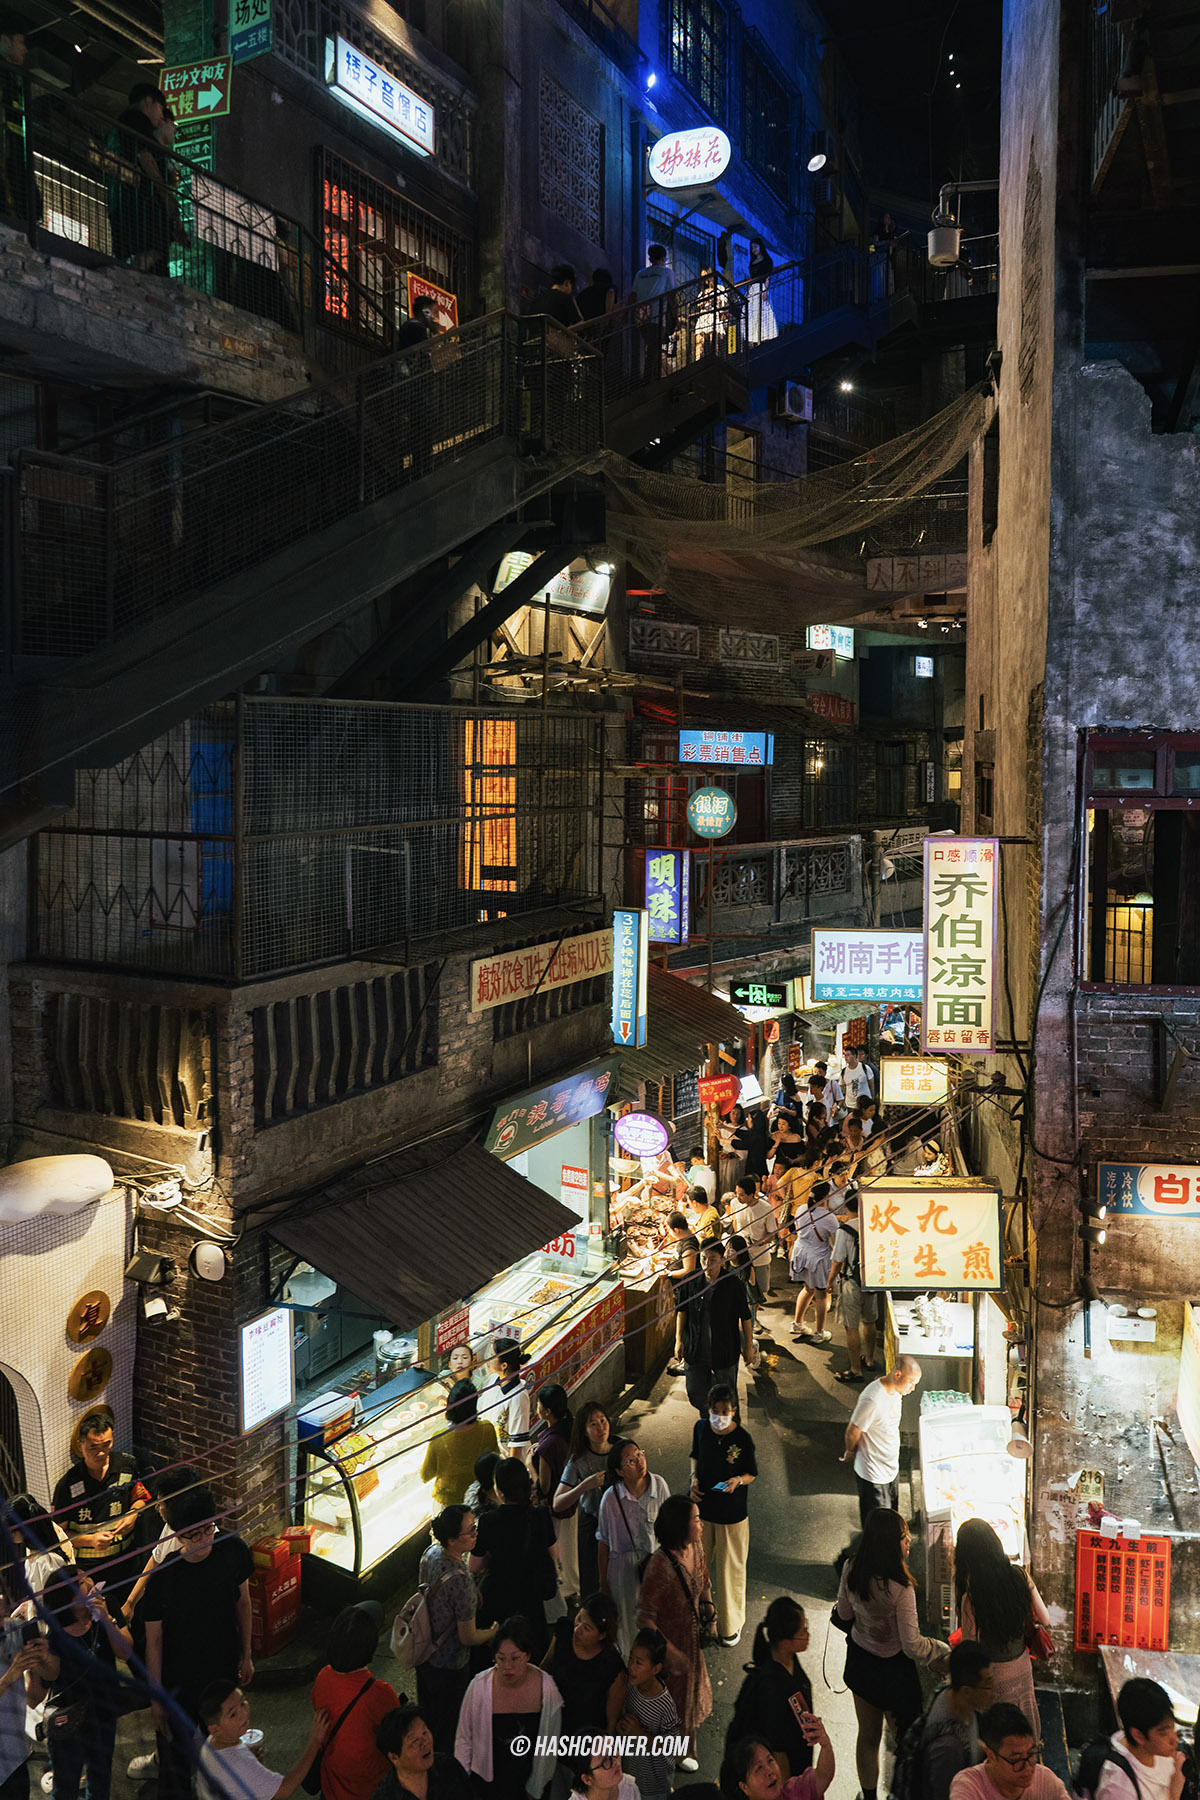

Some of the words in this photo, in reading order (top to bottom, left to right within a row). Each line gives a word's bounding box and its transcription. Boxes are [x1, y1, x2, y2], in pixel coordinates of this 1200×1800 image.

[247, 28, 269, 49] 五楼
[164, 62, 228, 91] 长沙文和友
[346, 50, 427, 134] 矮子音像店
[165, 89, 195, 117] 六楼
[656, 135, 722, 176] 姊妹花
[413, 281, 453, 312] 长沙文和友
[681, 742, 763, 765] 彩票销售点
[693, 794, 730, 816] 银河
[934, 848, 994, 863] 口感顺滑
[647, 853, 678, 924] 明珠
[648, 924, 680, 939] 夜总会
[819, 940, 924, 976] 湖南手信
[929, 872, 989, 1028] 乔伯凉面
[477, 951, 547, 1004] 搞好饮食卫生
[619, 914, 635, 1020] 3至6楼电梯在您后面
[927, 1029, 991, 1045] 唇齿留香
[899, 1063, 934, 1076] 白沙
[900, 1077, 933, 1092] 商店
[496, 1108, 528, 1131] 南门口
[1105, 1170, 1118, 1208] 汽水
[1121, 1171, 1134, 1209] 冷饮
[868, 1199, 959, 1236] 炊九
[912, 1241, 995, 1282] 生煎
[1079, 1469, 1103, 1485] 816
[77, 1500, 122, 1522] 执勤
[1089, 1536, 1158, 1554] 炊九生煎
[1110, 1556, 1121, 1594] 鲜肉煎饺
[1124, 1557, 1136, 1623] 老坛酸菜生煎包
[1139, 1559, 1151, 1607] 虾仁生煎包
[1153, 1560, 1165, 1607] 鲜肉生煎包
